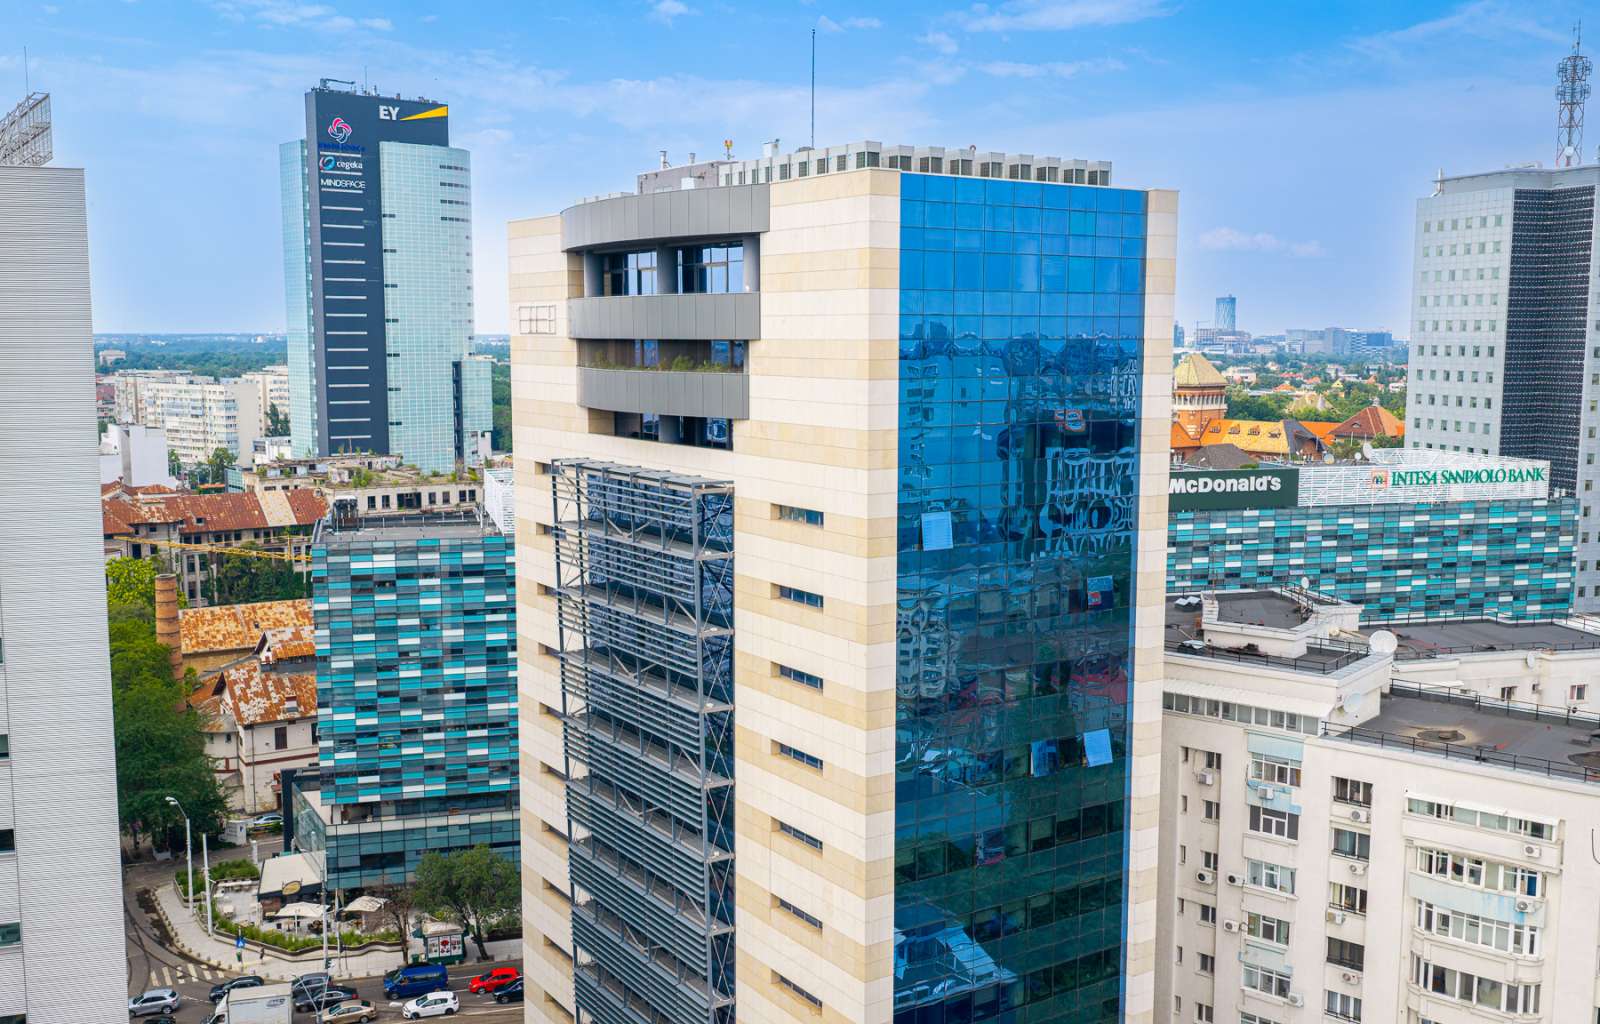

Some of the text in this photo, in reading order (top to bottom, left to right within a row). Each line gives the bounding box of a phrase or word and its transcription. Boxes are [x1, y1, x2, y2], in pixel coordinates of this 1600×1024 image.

[379, 105, 400, 121] EY
[336, 160, 363, 170] cegeka
[320, 178, 366, 189] MINDSPACE
[1168, 475, 1282, 494] McDonald's
[1391, 467, 1545, 486] INTESA SANPAOLO BANK
